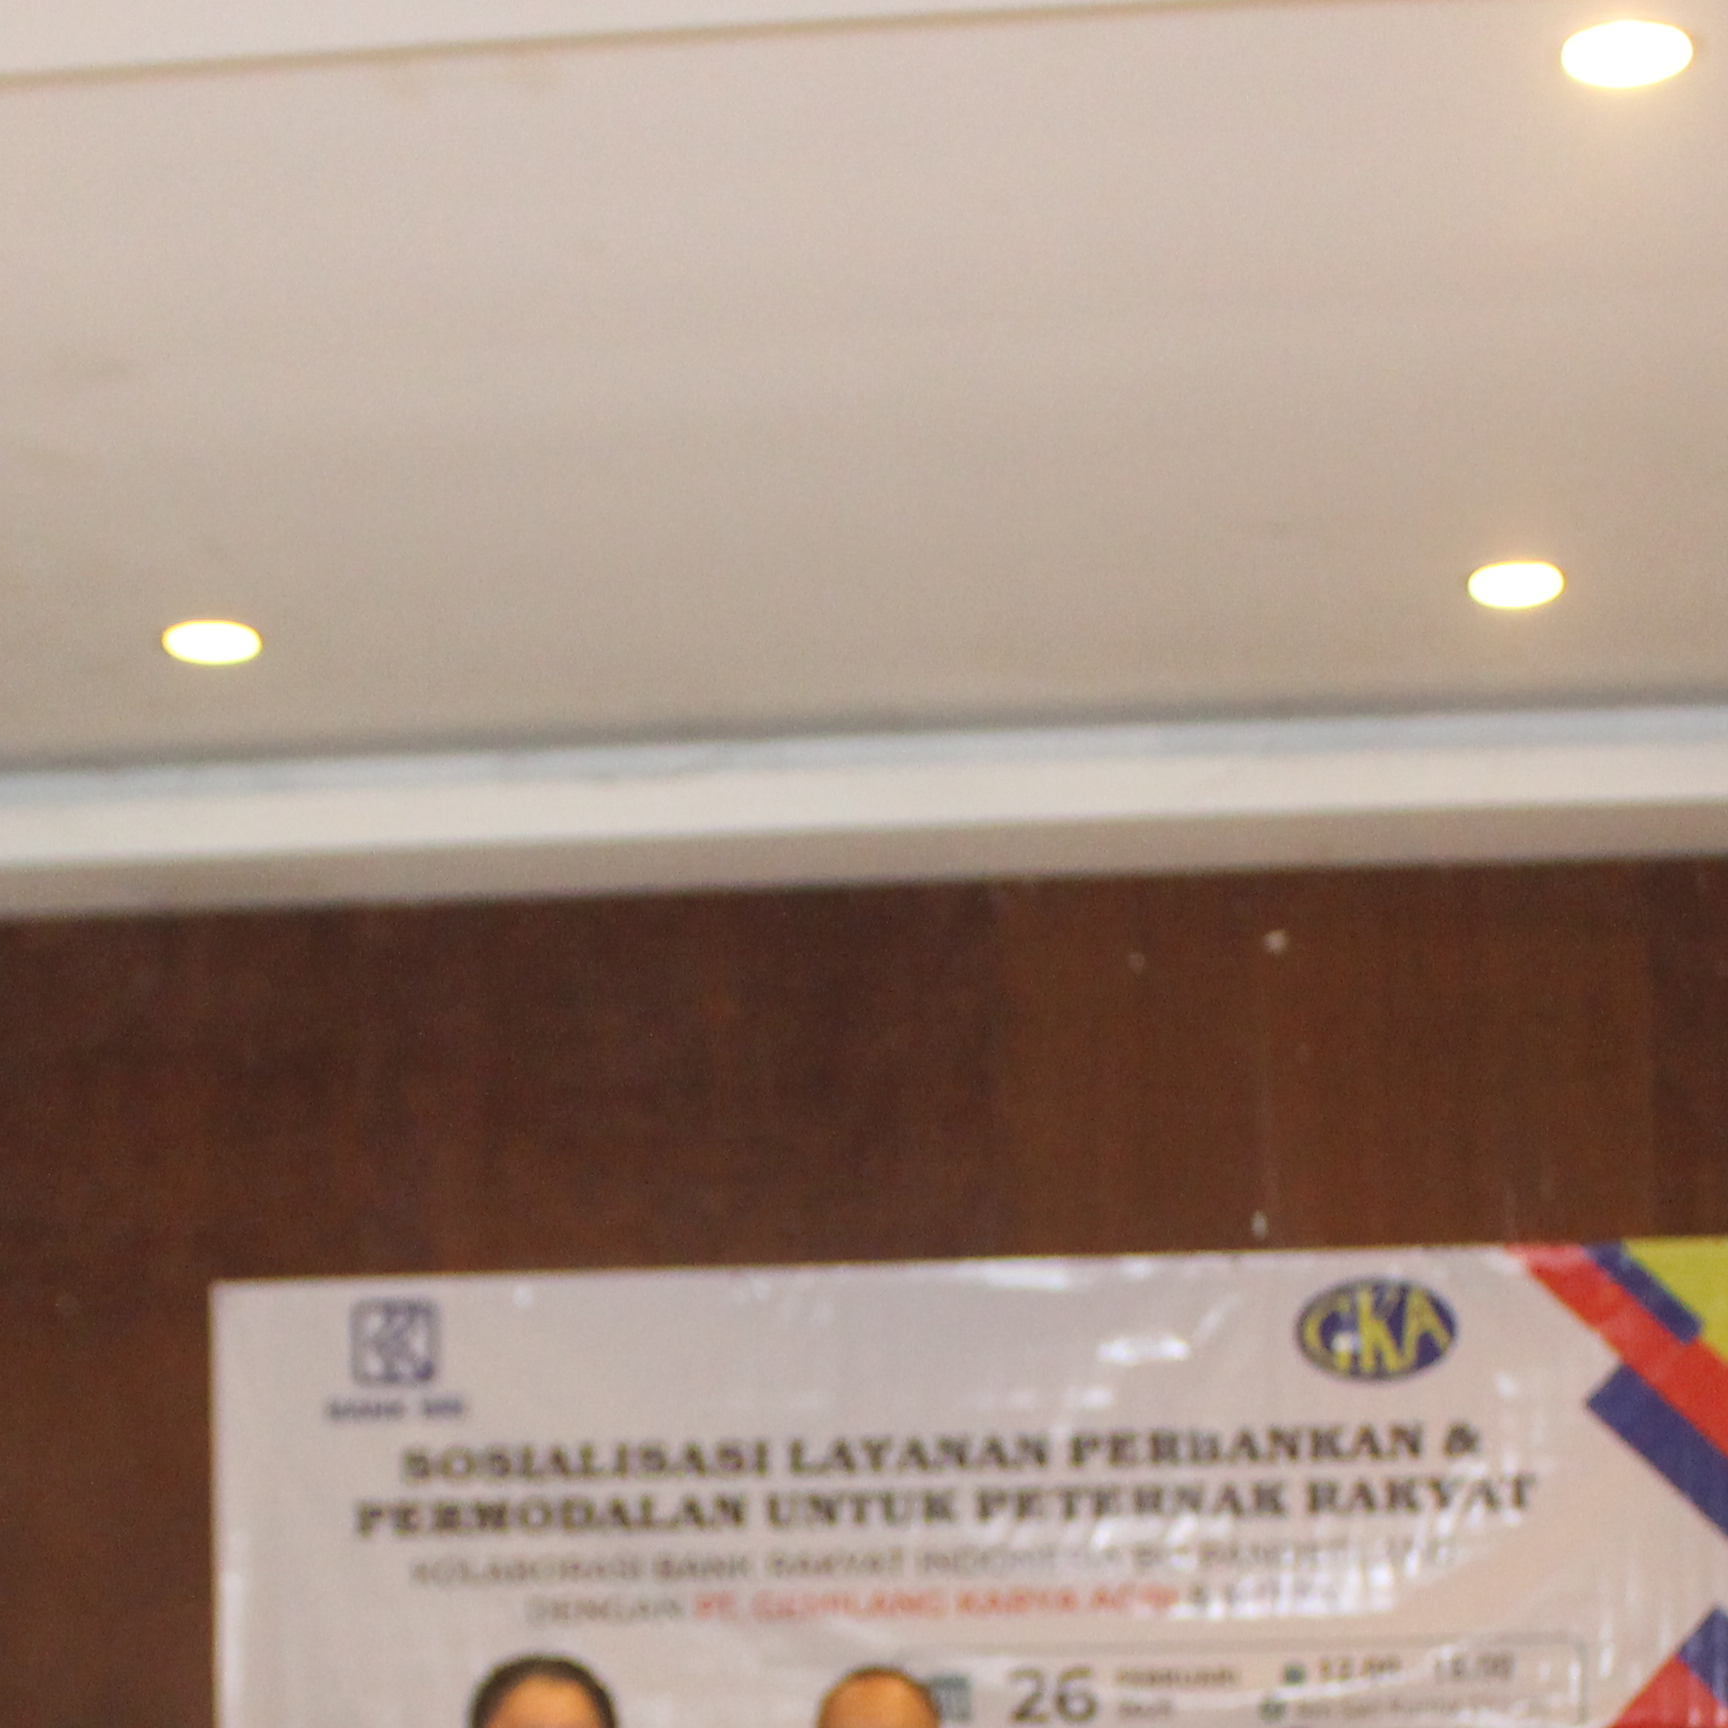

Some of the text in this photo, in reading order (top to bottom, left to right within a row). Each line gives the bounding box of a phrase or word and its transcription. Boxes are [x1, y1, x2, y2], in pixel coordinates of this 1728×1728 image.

[1299, 1280, 1455, 1377] GKA
[402, 1438, 769, 1484] SOSIALISASI
[788, 1433, 1049, 1475] LAYANAN
[1067, 1423, 1424, 1468] PERBANKAN
[354, 1472, 1537, 1538] PERMODALAN UNTUK PETERNAK RAKYAT
[1007, 1664, 1099, 1724] 26
